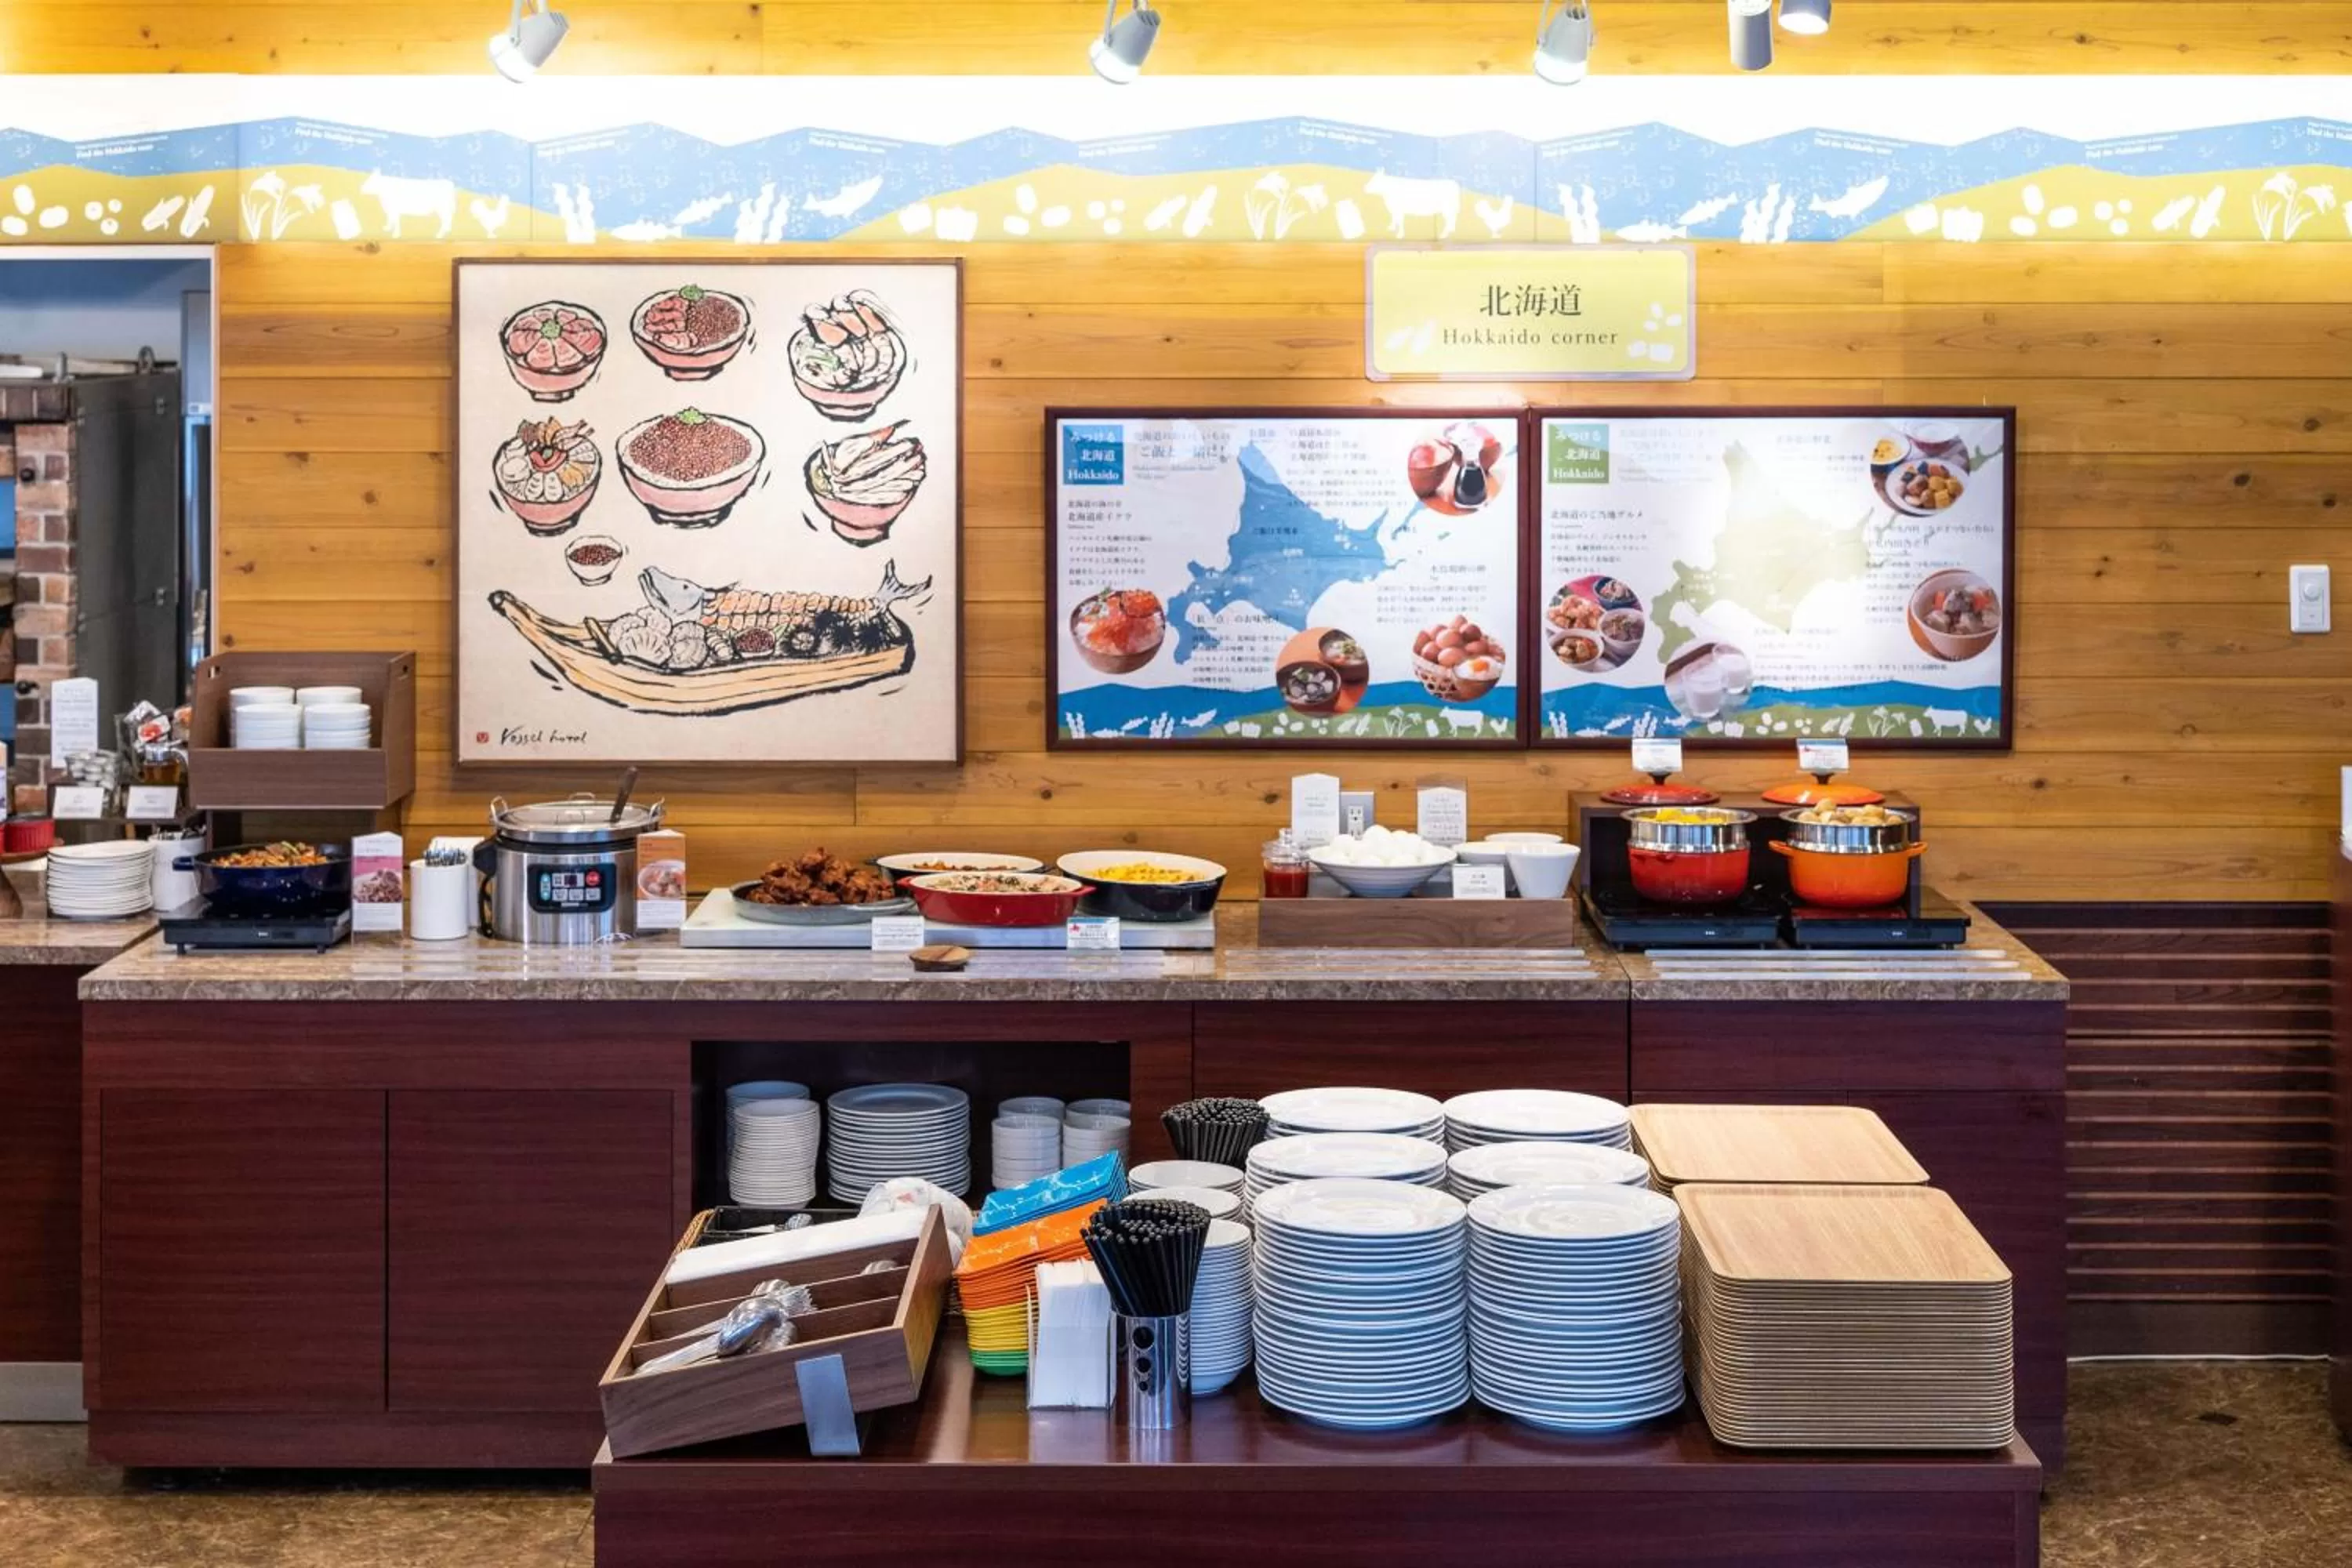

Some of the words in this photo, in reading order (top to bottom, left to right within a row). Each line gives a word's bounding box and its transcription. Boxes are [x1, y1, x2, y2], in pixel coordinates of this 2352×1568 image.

[1479, 284, 1582, 317] 北海道
[1443, 328, 1541, 345] Hokkaido
[1551, 331, 1619, 345] corner
[1080, 449, 1116, 461] 北海道
[1565, 448, 1601, 461] 北海道
[1068, 468, 1120, 481] Hokkaido
[1553, 467, 1605, 479] Hokkaido
